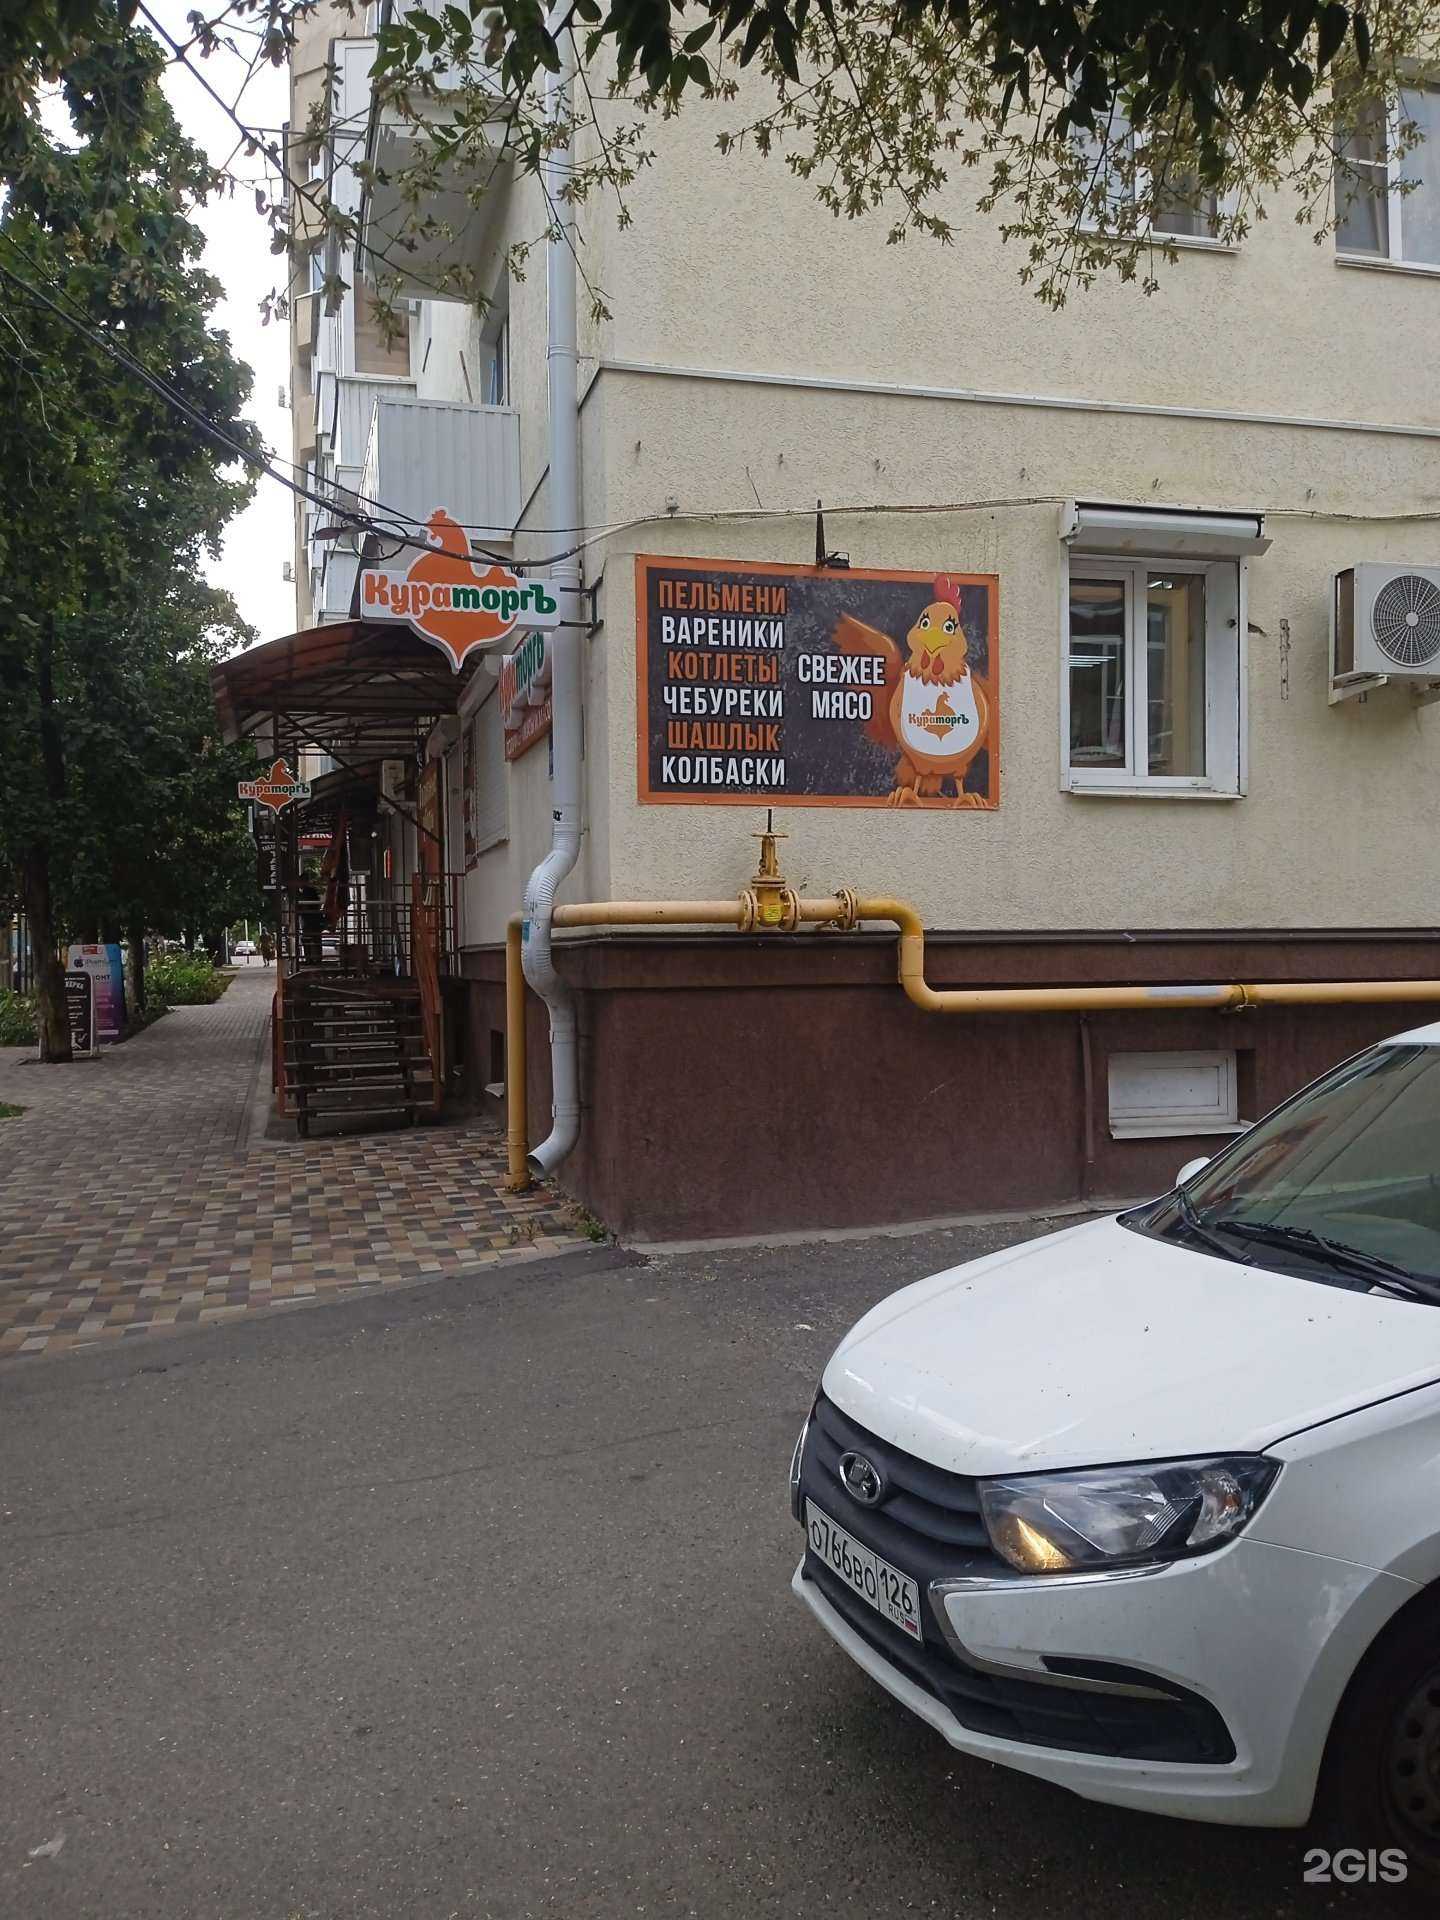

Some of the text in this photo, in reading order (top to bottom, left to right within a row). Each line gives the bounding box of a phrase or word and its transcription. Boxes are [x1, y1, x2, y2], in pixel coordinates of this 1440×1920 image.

[658, 580, 787, 614] ПЕЛЬМЕНИ
[661, 616, 784, 649] ВАРЕНИКИ
[668, 651, 779, 683] КОТЛЕТЫ
[798, 653, 885, 685] СВЕЖЕЕ
[663, 686, 784, 718] ЧЕБУРЕКИ
[812, 690, 872, 721] МЯСО
[667, 720, 782, 751] ШАШЛЫК
[661, 755, 785, 786] КОЛБАСКИ
